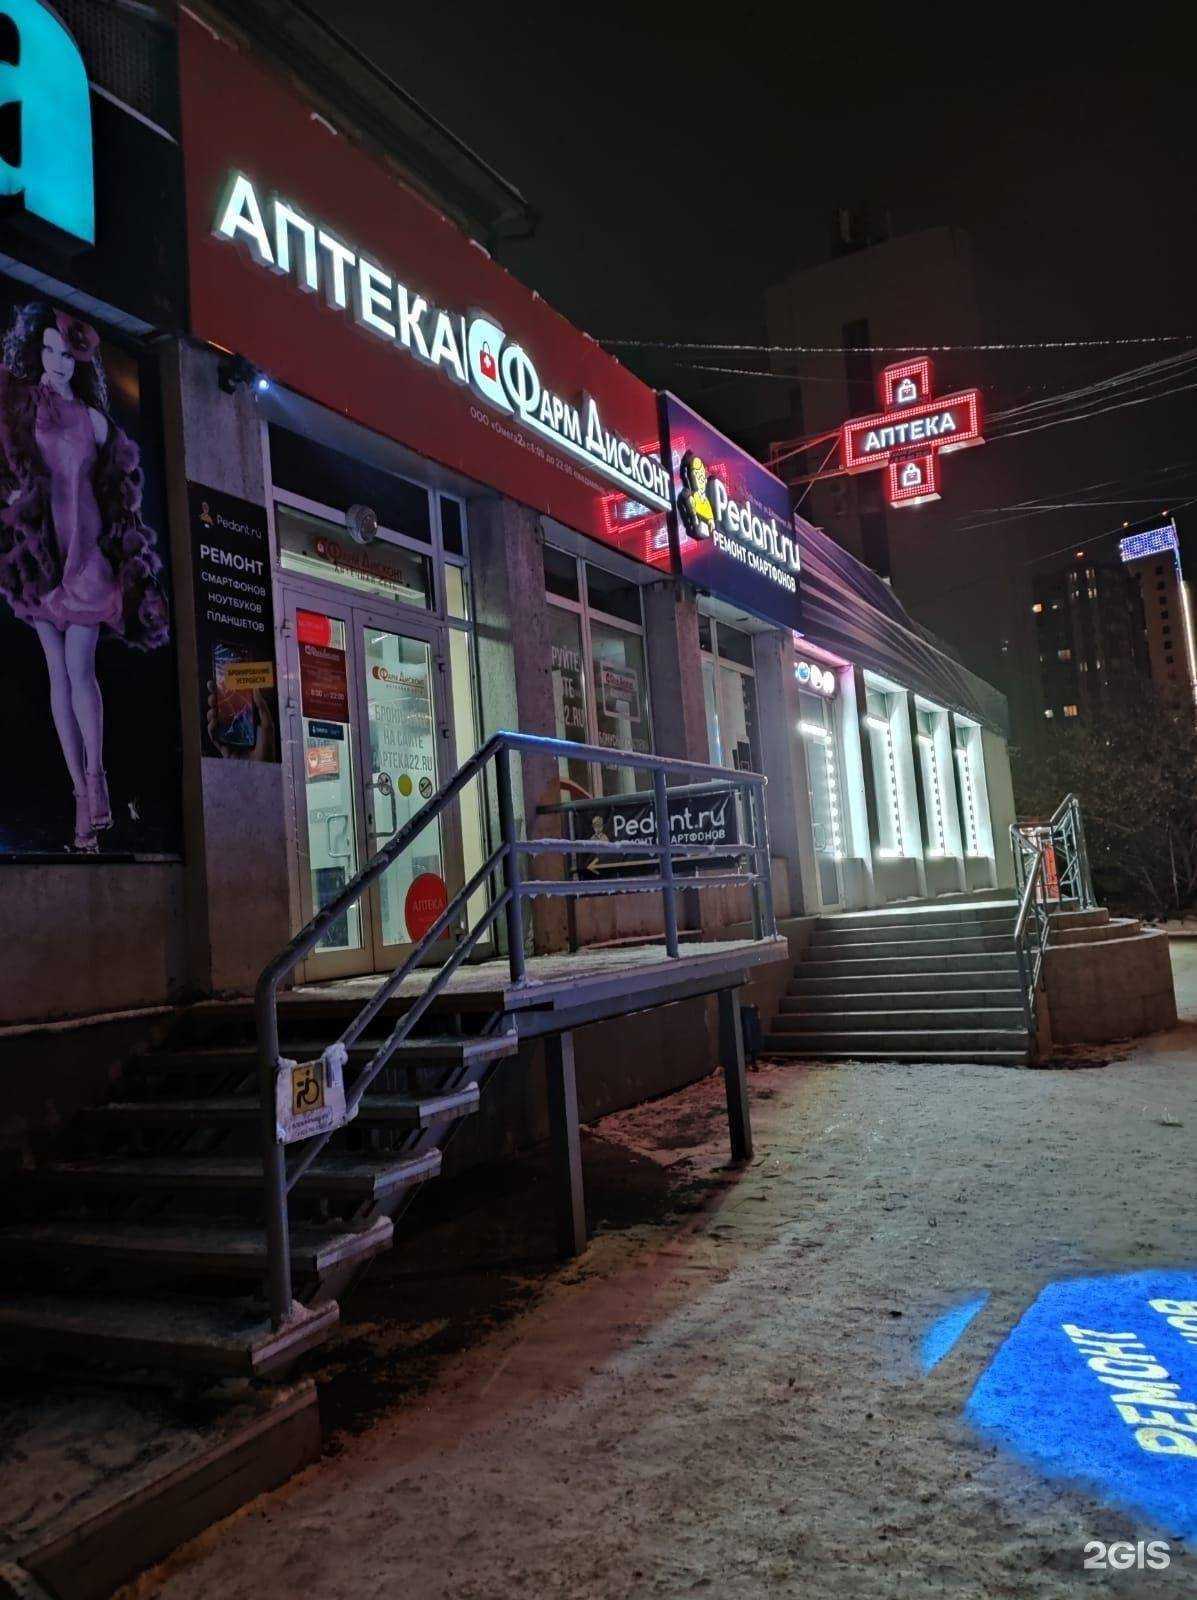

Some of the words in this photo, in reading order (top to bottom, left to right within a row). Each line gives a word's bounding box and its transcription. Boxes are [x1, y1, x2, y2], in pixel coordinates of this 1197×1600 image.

[213, 172, 467, 384] АПТЕКА
[585, 396, 671, 501] ДИСКОНТ
[470, 406, 490, 426] ООО
[864, 411, 957, 452] АПТЕКА
[199, 543, 264, 576] РЕМОНТ
[713, 530, 747, 563] РЕМОНТ
[748, 551, 796, 593] СМАРТФОНОВ
[201, 570, 266, 598] СМАРТФОНОВ
[208, 592, 262, 614] НОУТБУКОВ
[206, 610, 265, 633] ПЛАНШЕТОВ
[613, 807, 724, 837] Pednt.ru
[1062, 1323, 1197, 1459] РЕМОНТ
